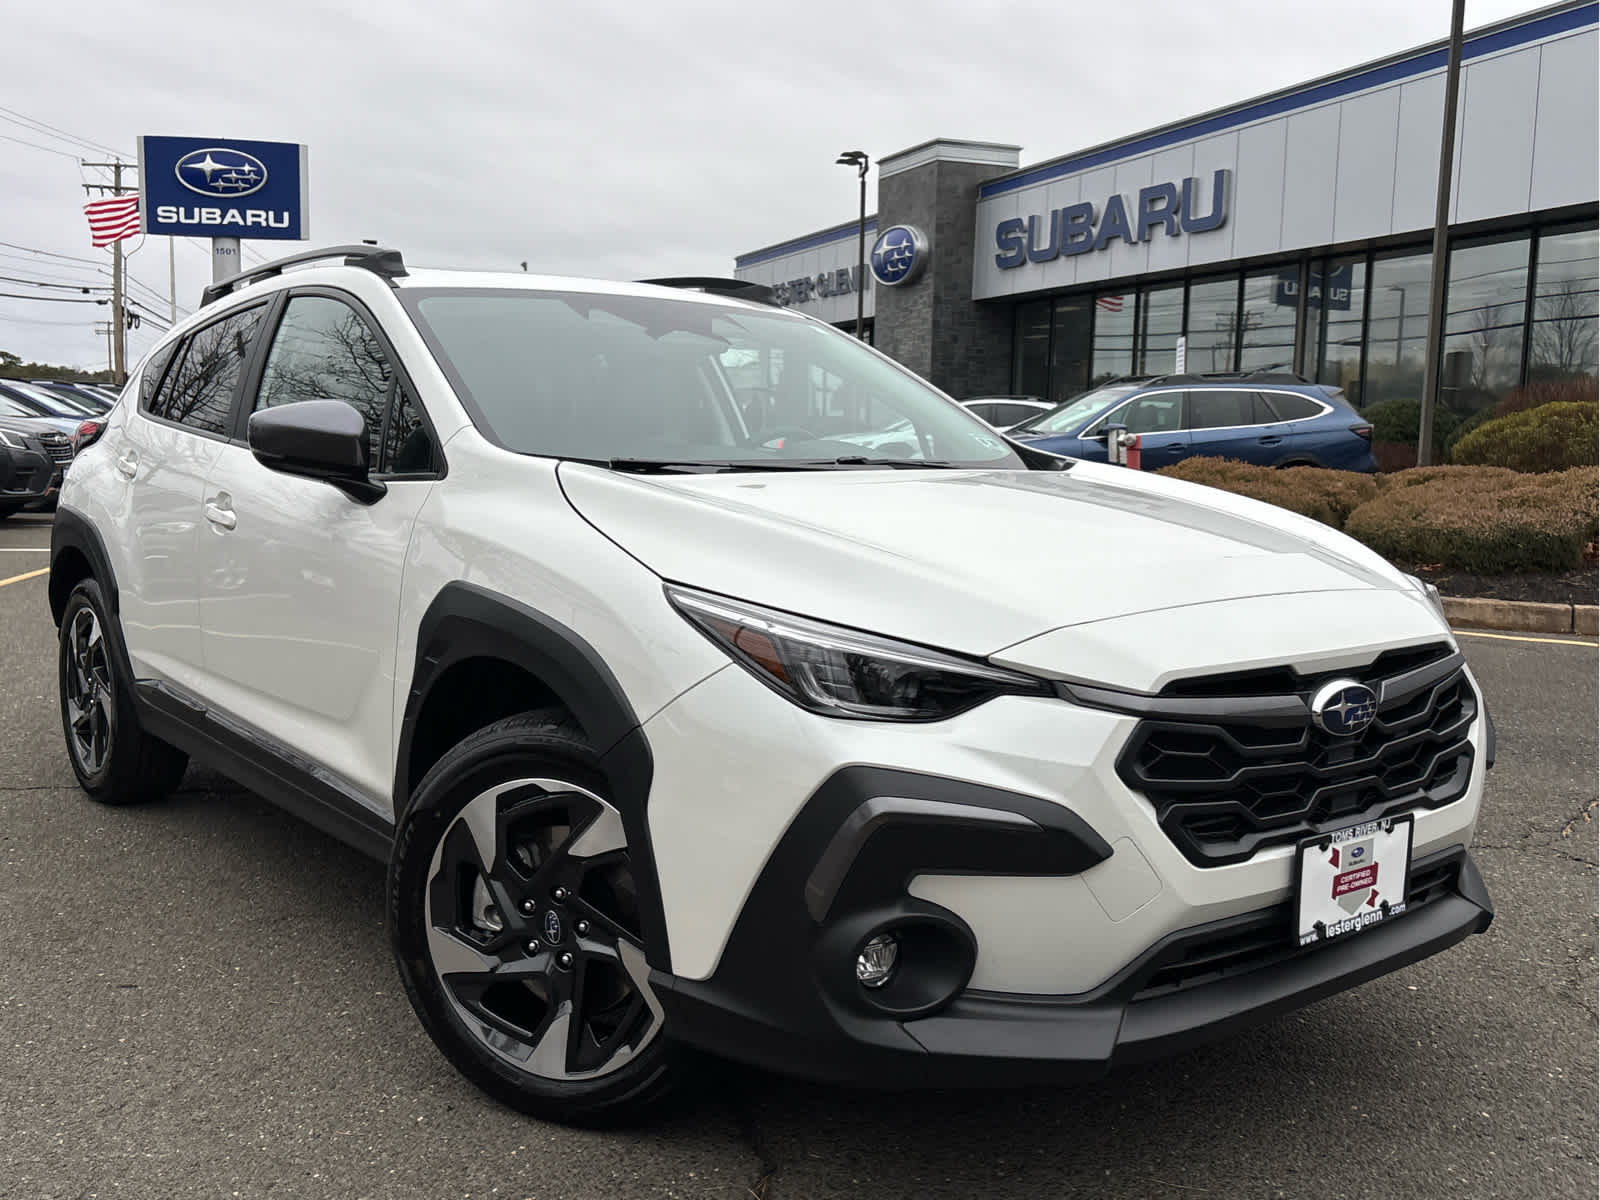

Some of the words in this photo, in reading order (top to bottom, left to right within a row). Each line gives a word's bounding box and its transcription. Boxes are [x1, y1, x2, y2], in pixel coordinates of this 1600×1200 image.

[156, 205, 290, 228] SUBARU
[995, 169, 1231, 270] SUBARU
[215, 247, 237, 256] 1501
[1331, 828, 1353, 843] TOMS
[1380, 818, 1391, 831] NJ
[1340, 869, 1371, 884] CERTIFIED
[1325, 910, 1383, 938] lesterglenn
